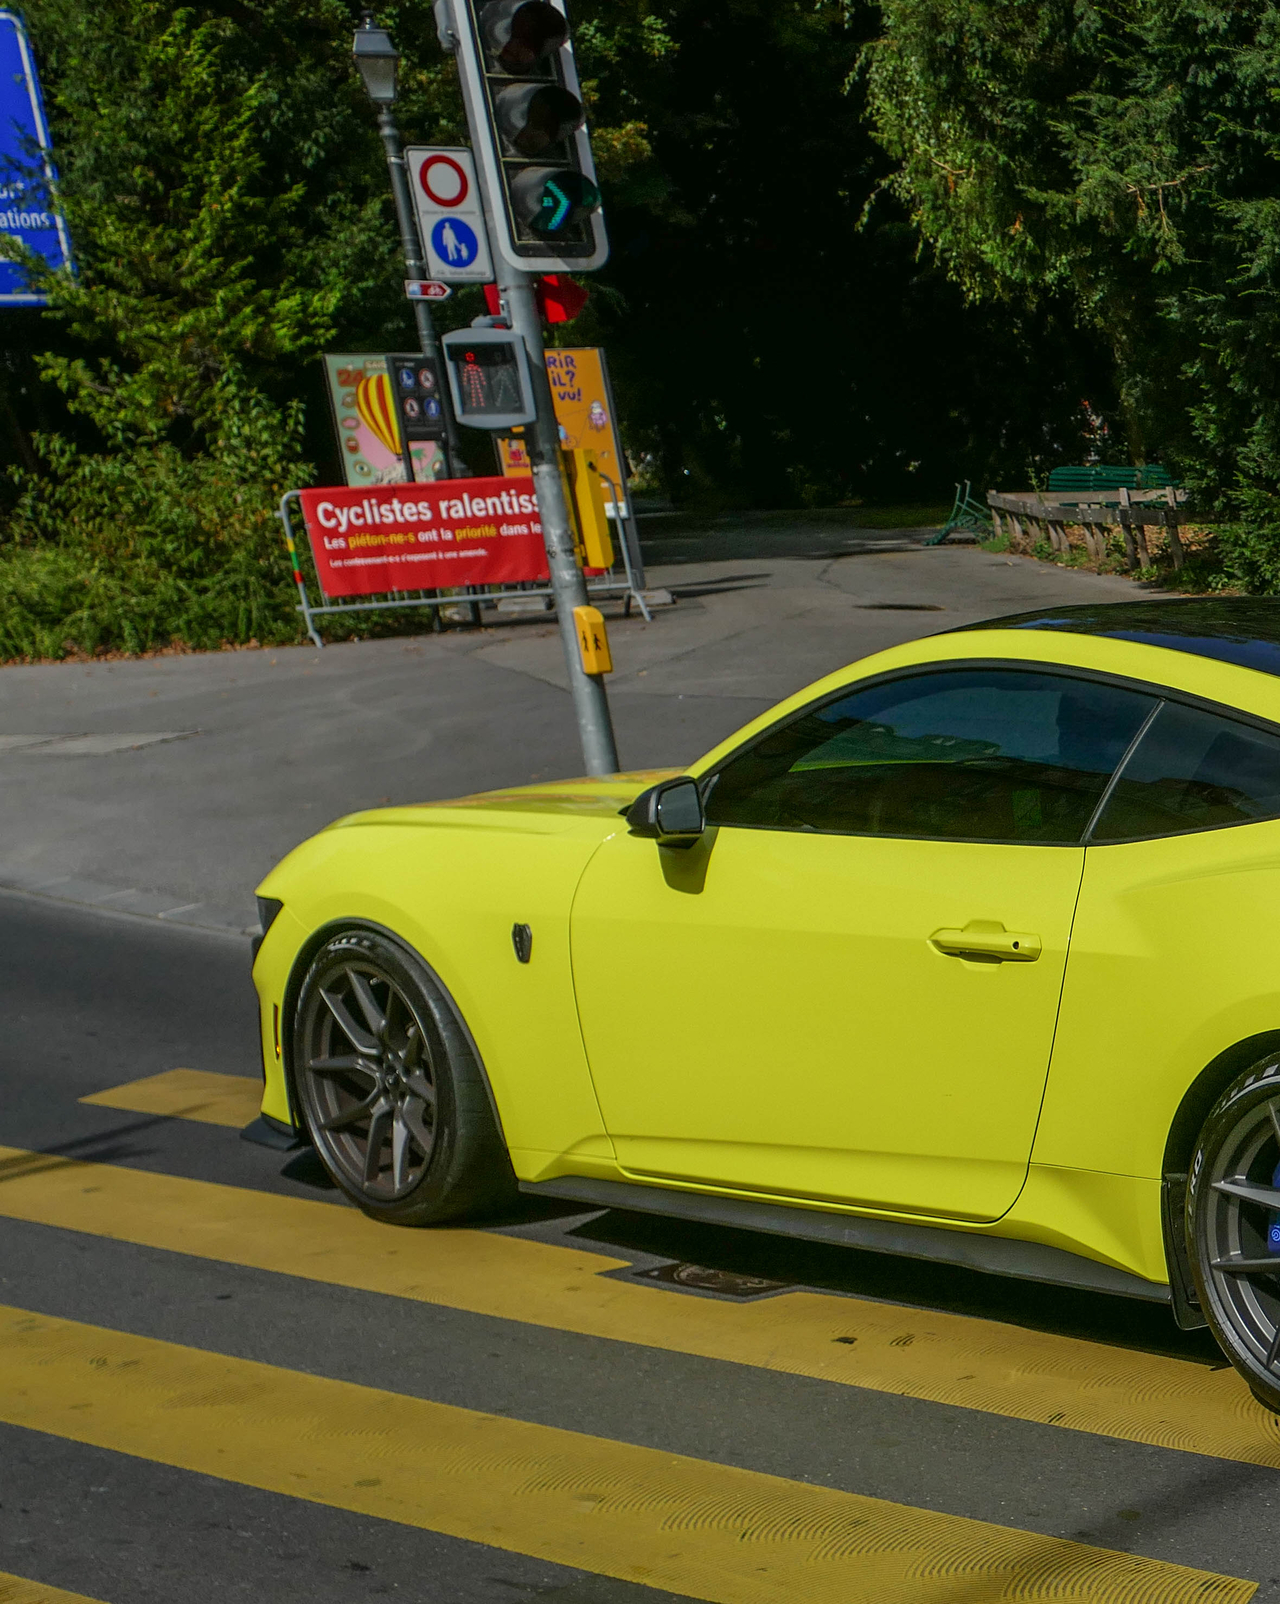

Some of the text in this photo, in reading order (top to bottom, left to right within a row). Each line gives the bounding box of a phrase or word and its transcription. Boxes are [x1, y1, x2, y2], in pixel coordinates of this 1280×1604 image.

[317, 497, 432, 533] Cyclistes
[324, 536, 346, 550] Les
[418, 528, 438, 543] ont
[441, 527, 453, 540] la
[455, 524, 497, 543] priorité
[500, 521, 528, 537] dans
